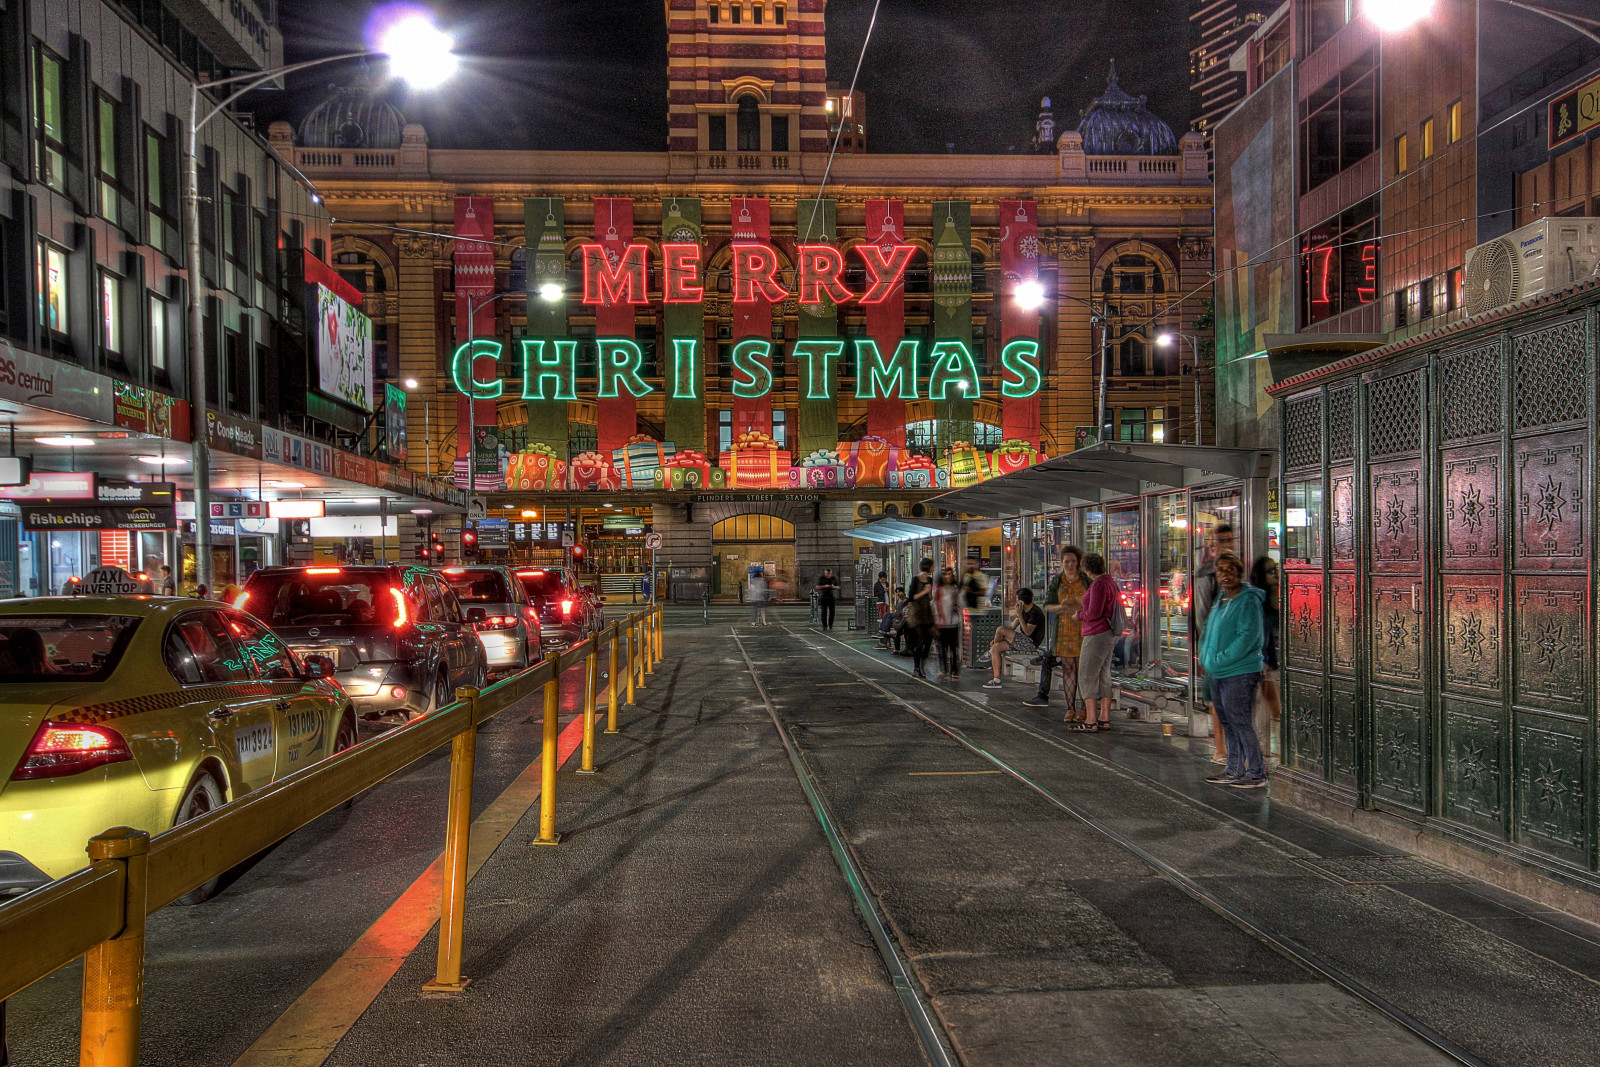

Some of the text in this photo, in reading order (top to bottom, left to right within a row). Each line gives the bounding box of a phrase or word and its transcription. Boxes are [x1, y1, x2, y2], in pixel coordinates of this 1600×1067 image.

[1520, 233, 1544, 249] Panasonic
[579, 242, 918, 304] MERRY
[451, 338, 1043, 401] CHRISTMAS
[17, 371, 54, 395] central
[216, 420, 233, 440] Cone
[235, 425, 254, 446] Heads
[1268, 490, 1276, 500] 24
[29, 512, 102, 527] fish&chips
[126, 512, 156, 520] WAGYU
[91, 570, 123, 584] TAXI
[75, 583, 138, 594] SILVER TOP
[301, 711, 315, 735] 008
[236, 726, 273, 755] TAXI 3924
[288, 749, 299, 763] TAXI
